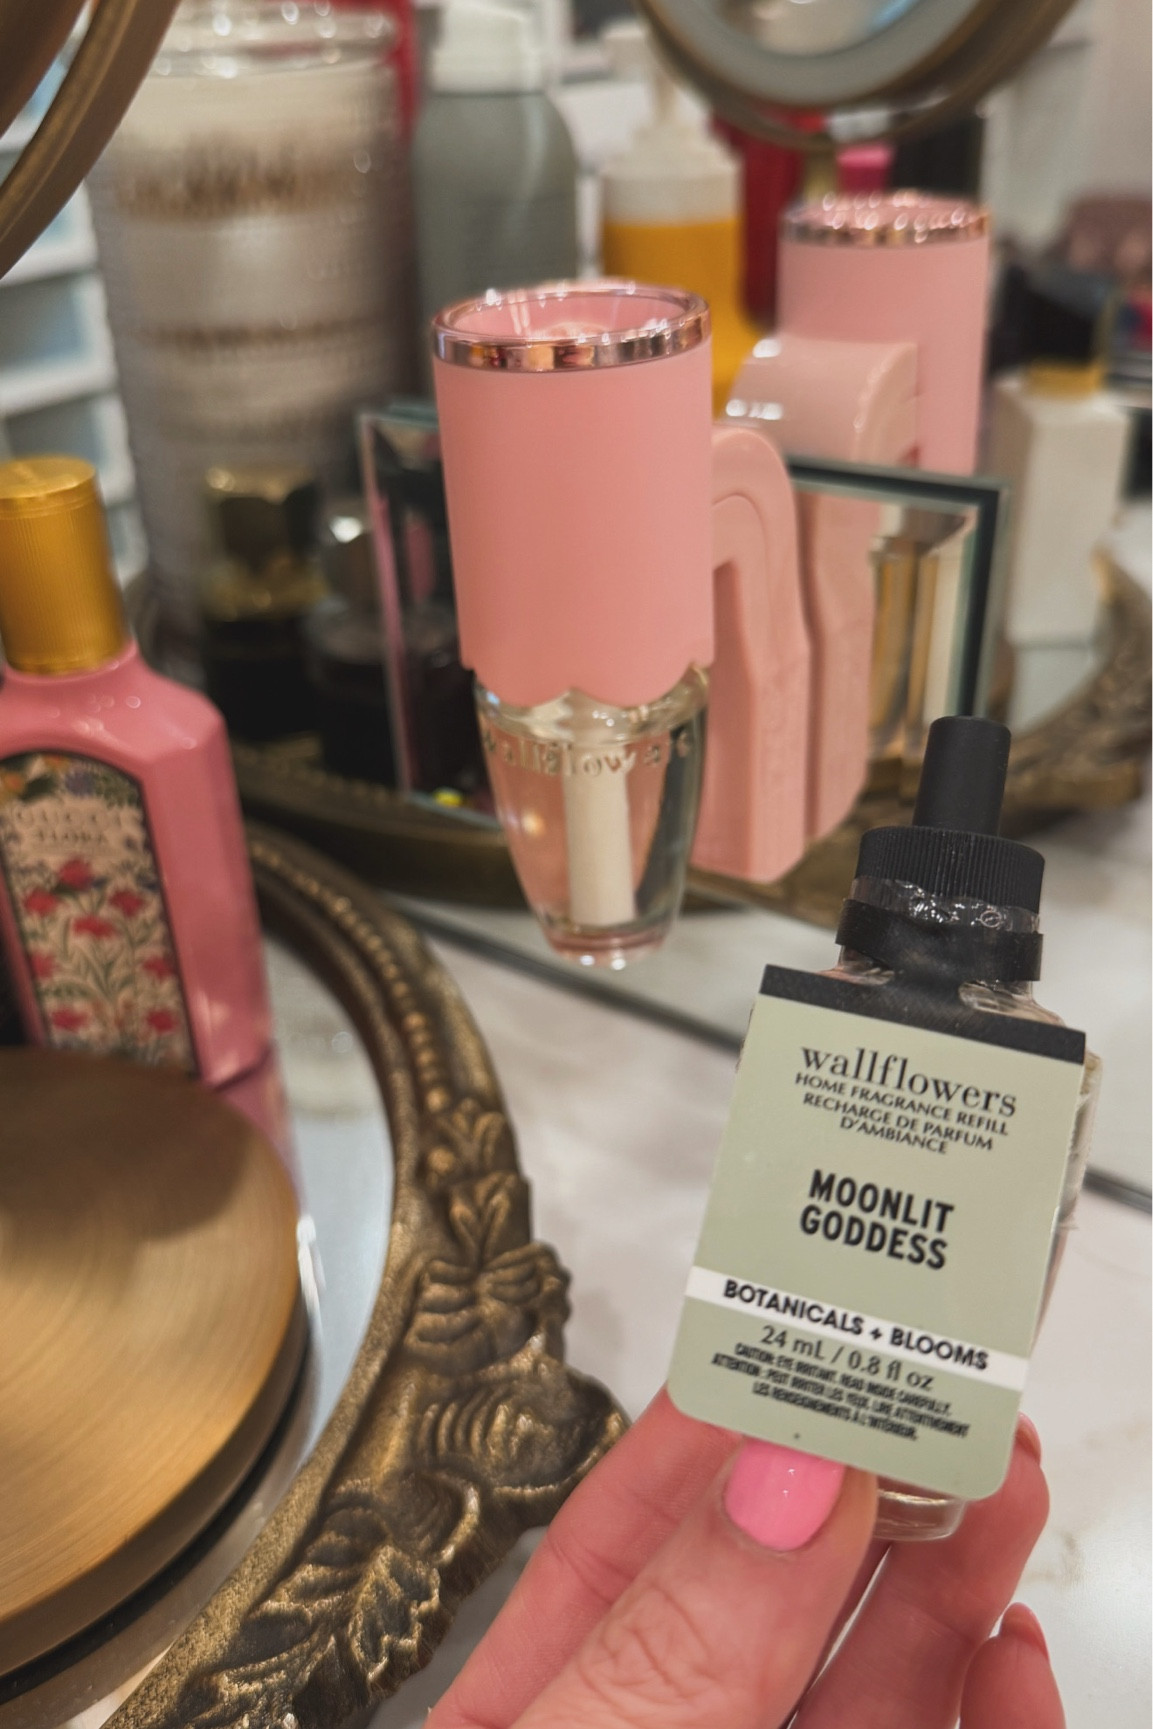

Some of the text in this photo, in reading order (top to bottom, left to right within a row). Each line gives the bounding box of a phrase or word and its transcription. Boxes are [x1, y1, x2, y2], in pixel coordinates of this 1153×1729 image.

[795, 1072, 1009, 1136] HOME FRAGRANCE REFILL
[801, 1047, 1016, 1117] wallflowers
[803, 1092, 993, 1151] RECHARGE DE PARFUM
[840, 1116, 949, 1154] D'AMBIANCE
[808, 1169, 955, 1234] MOONLIT
[800, 1204, 948, 1270] GODDESS
[723, 1279, 987, 1370] BOTANICALS + BLOOMS
[761, 1325, 934, 1391] 24 mL / 0.8 fl oz
